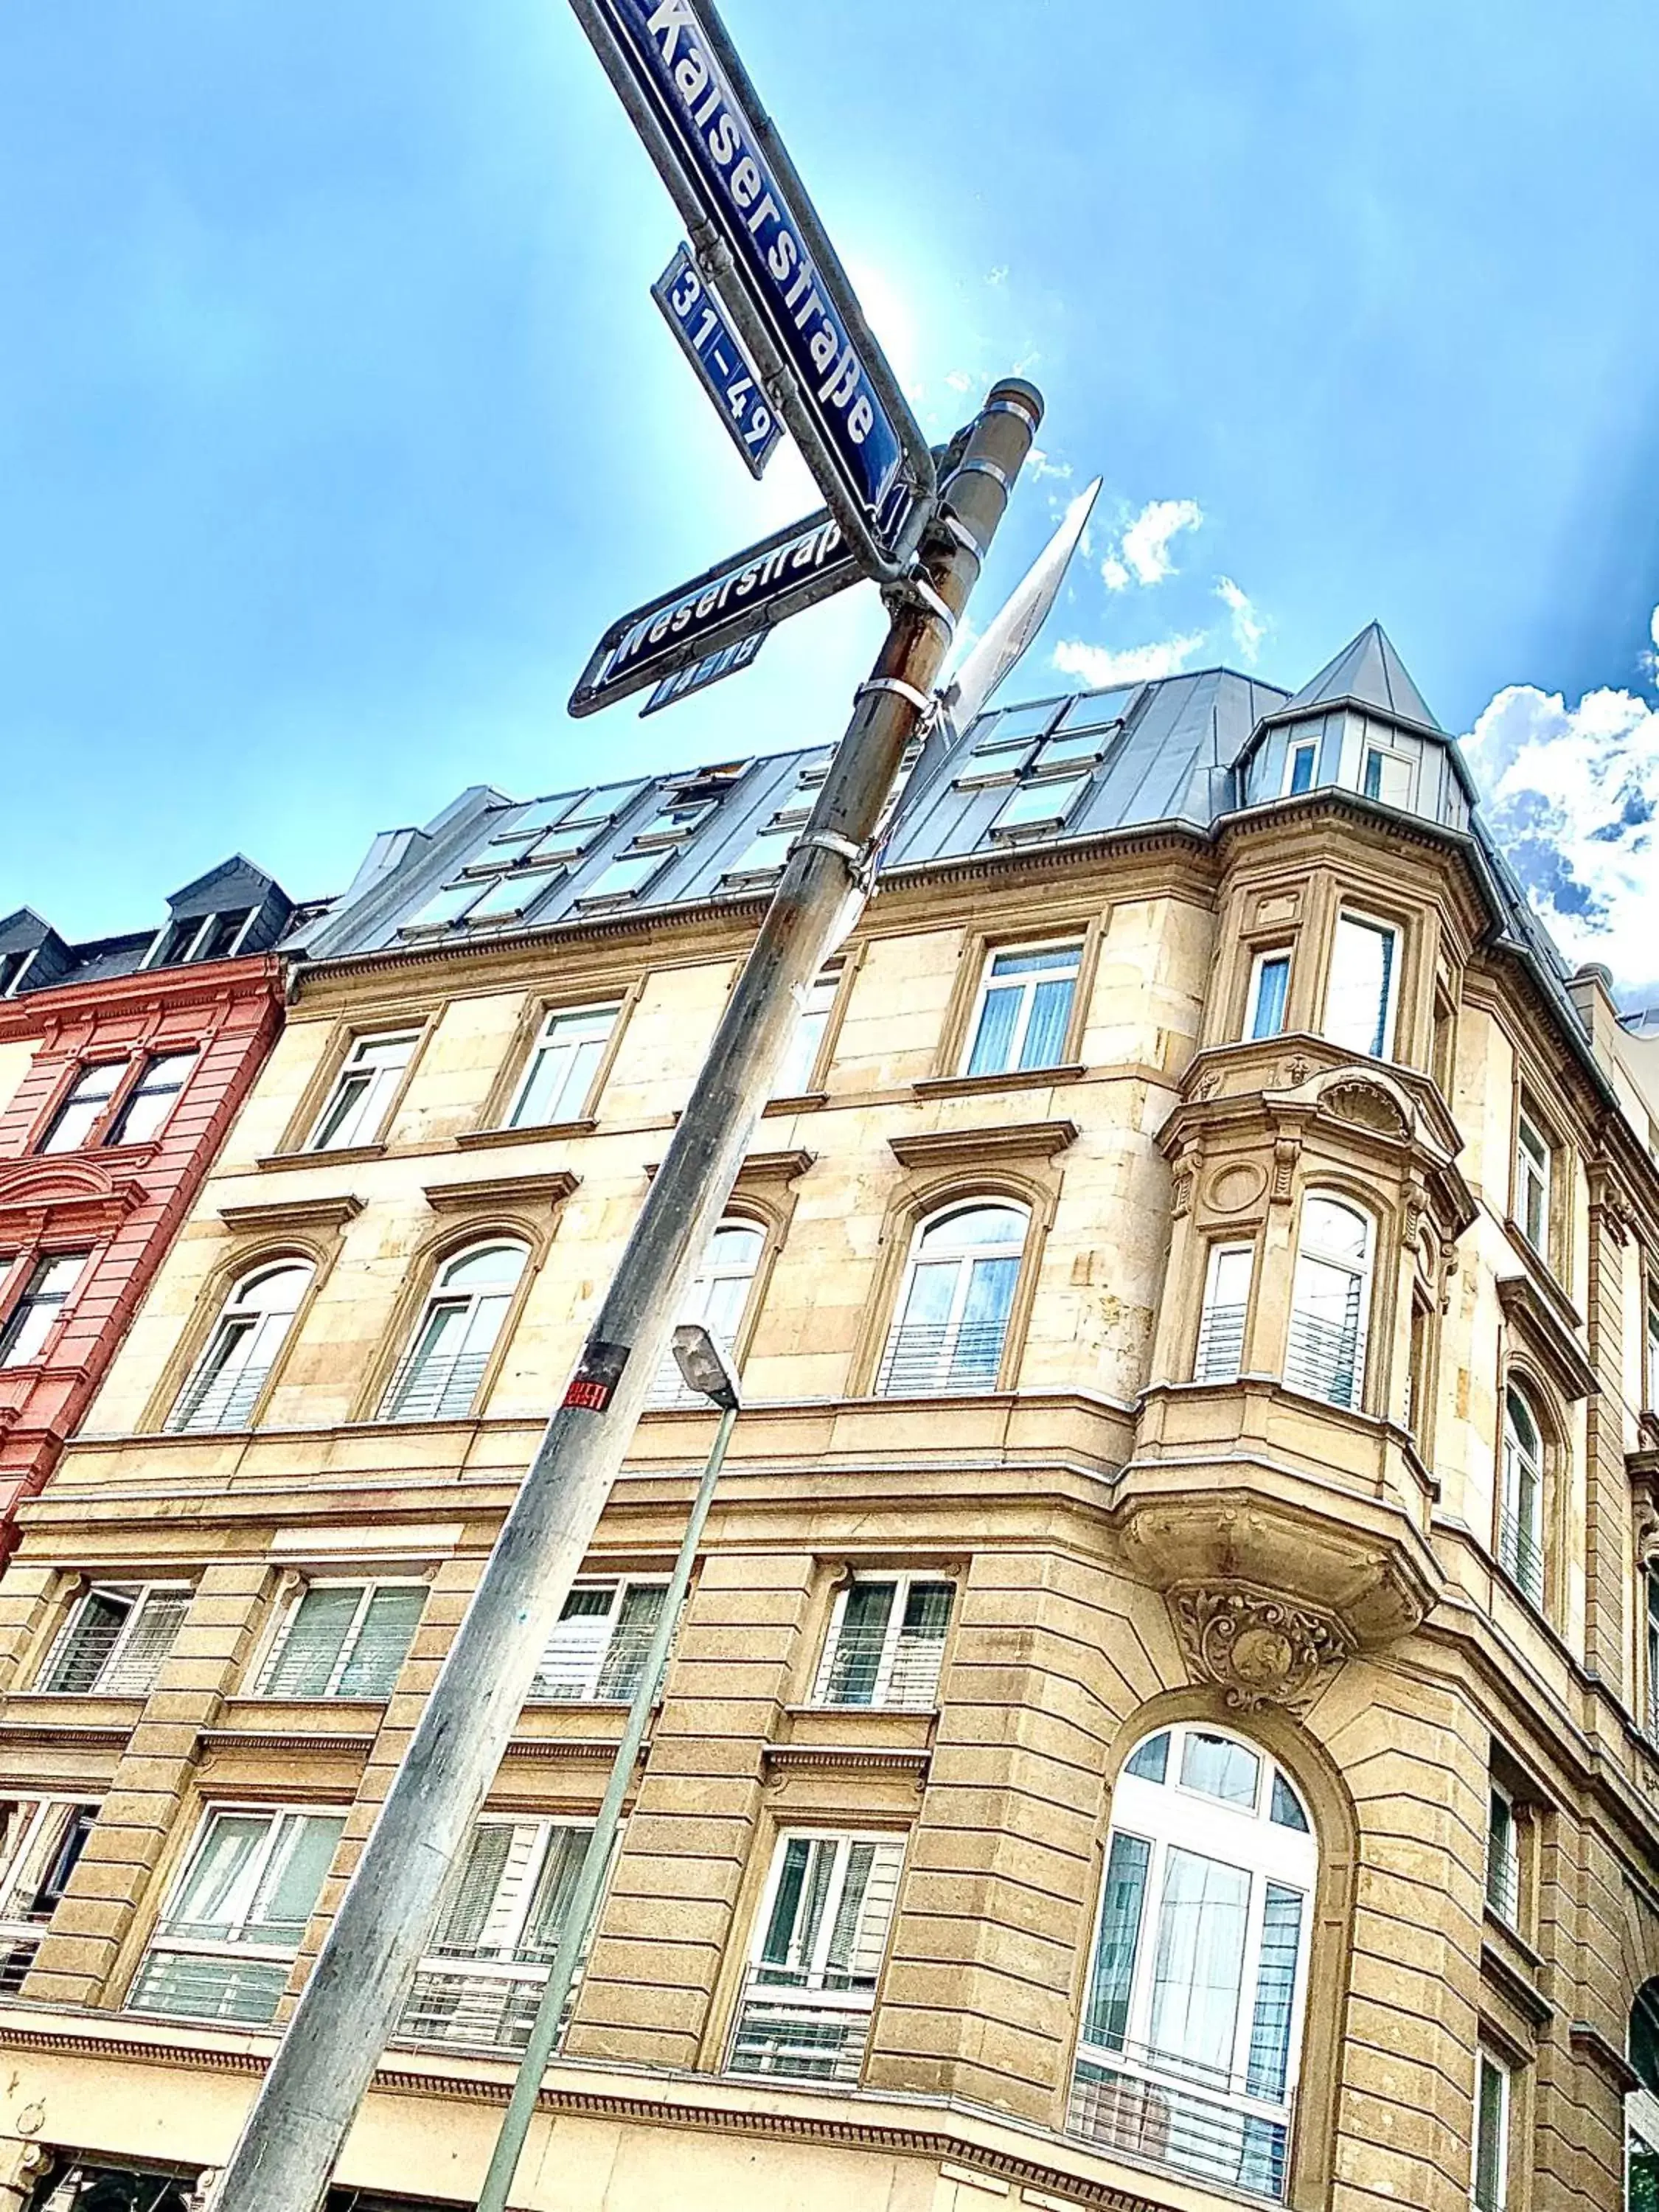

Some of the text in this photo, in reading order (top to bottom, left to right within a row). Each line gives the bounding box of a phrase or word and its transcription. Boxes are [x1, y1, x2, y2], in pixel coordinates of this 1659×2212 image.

[646, 0, 874, 444] Kaiserstraße
[672, 271, 771, 444] 31-49
[617, 519, 841, 661] Weserstraß
